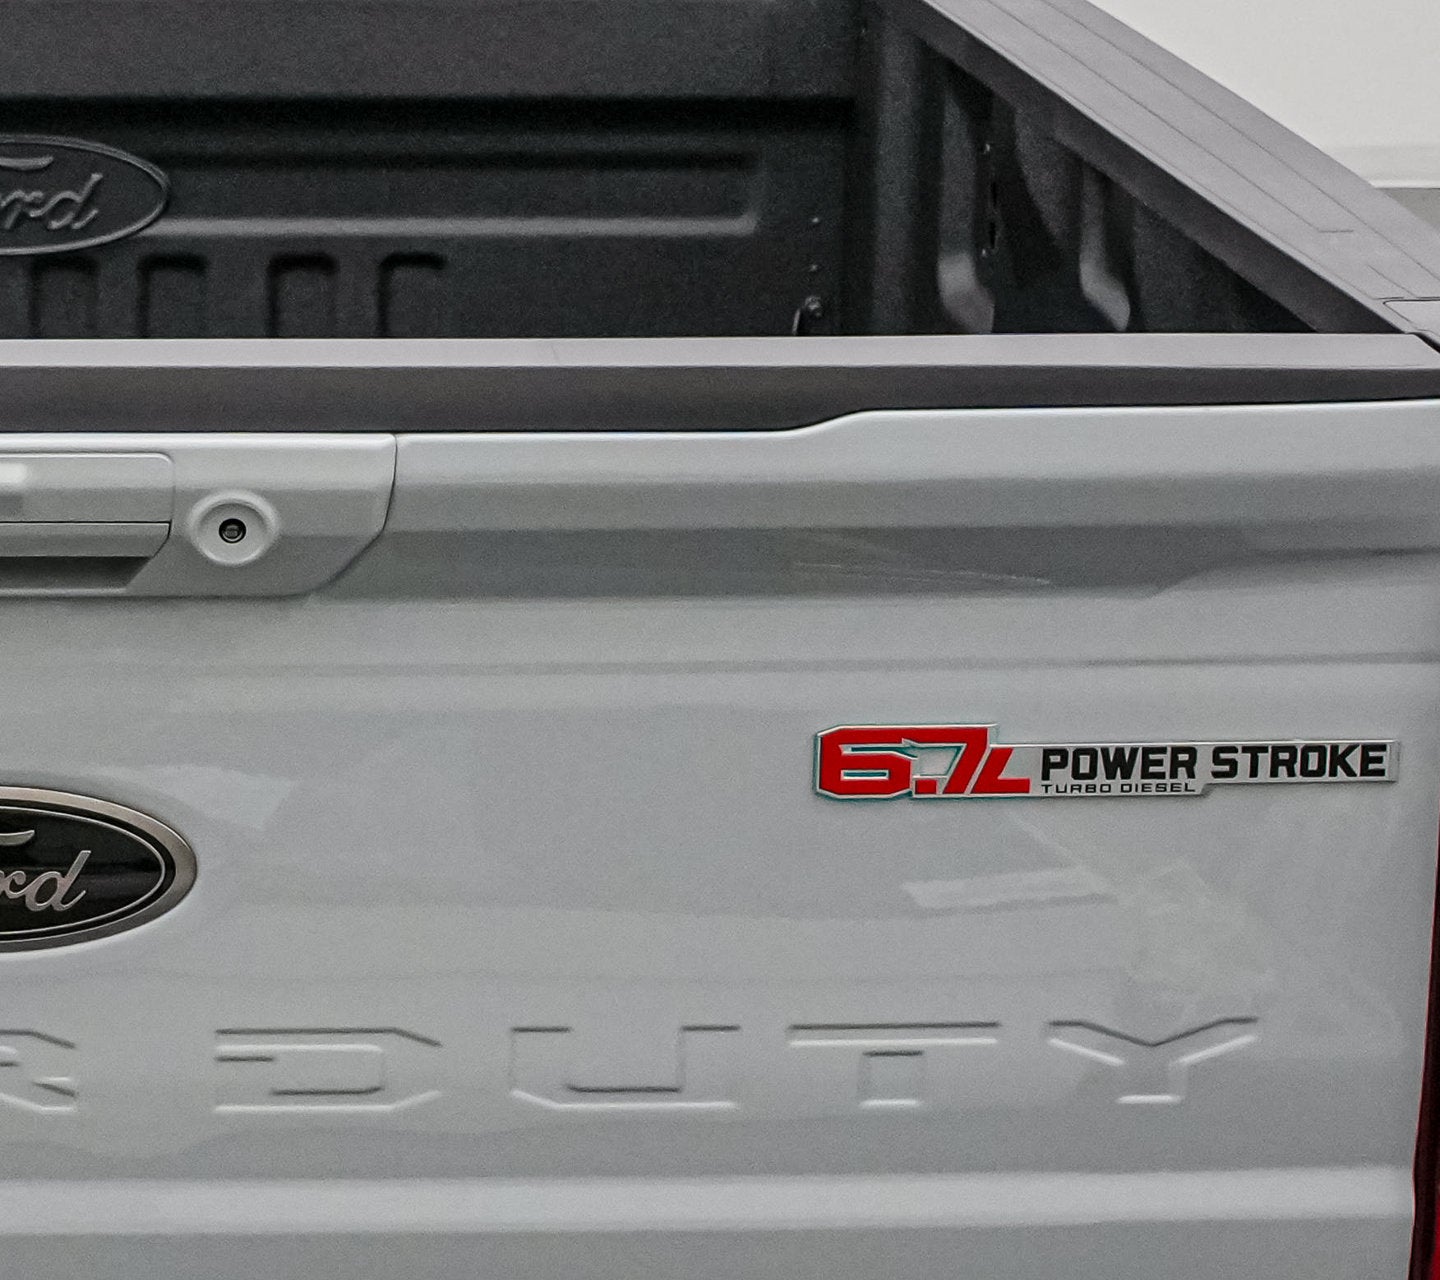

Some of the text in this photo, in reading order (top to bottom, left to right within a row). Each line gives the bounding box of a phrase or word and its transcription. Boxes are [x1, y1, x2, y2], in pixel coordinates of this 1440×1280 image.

[819, 728, 1387, 795] 6.7L POWER STROKE
[1041, 782, 1196, 794] TURBO DIESEL
[214, 1017, 1260, 1113] DUTY
